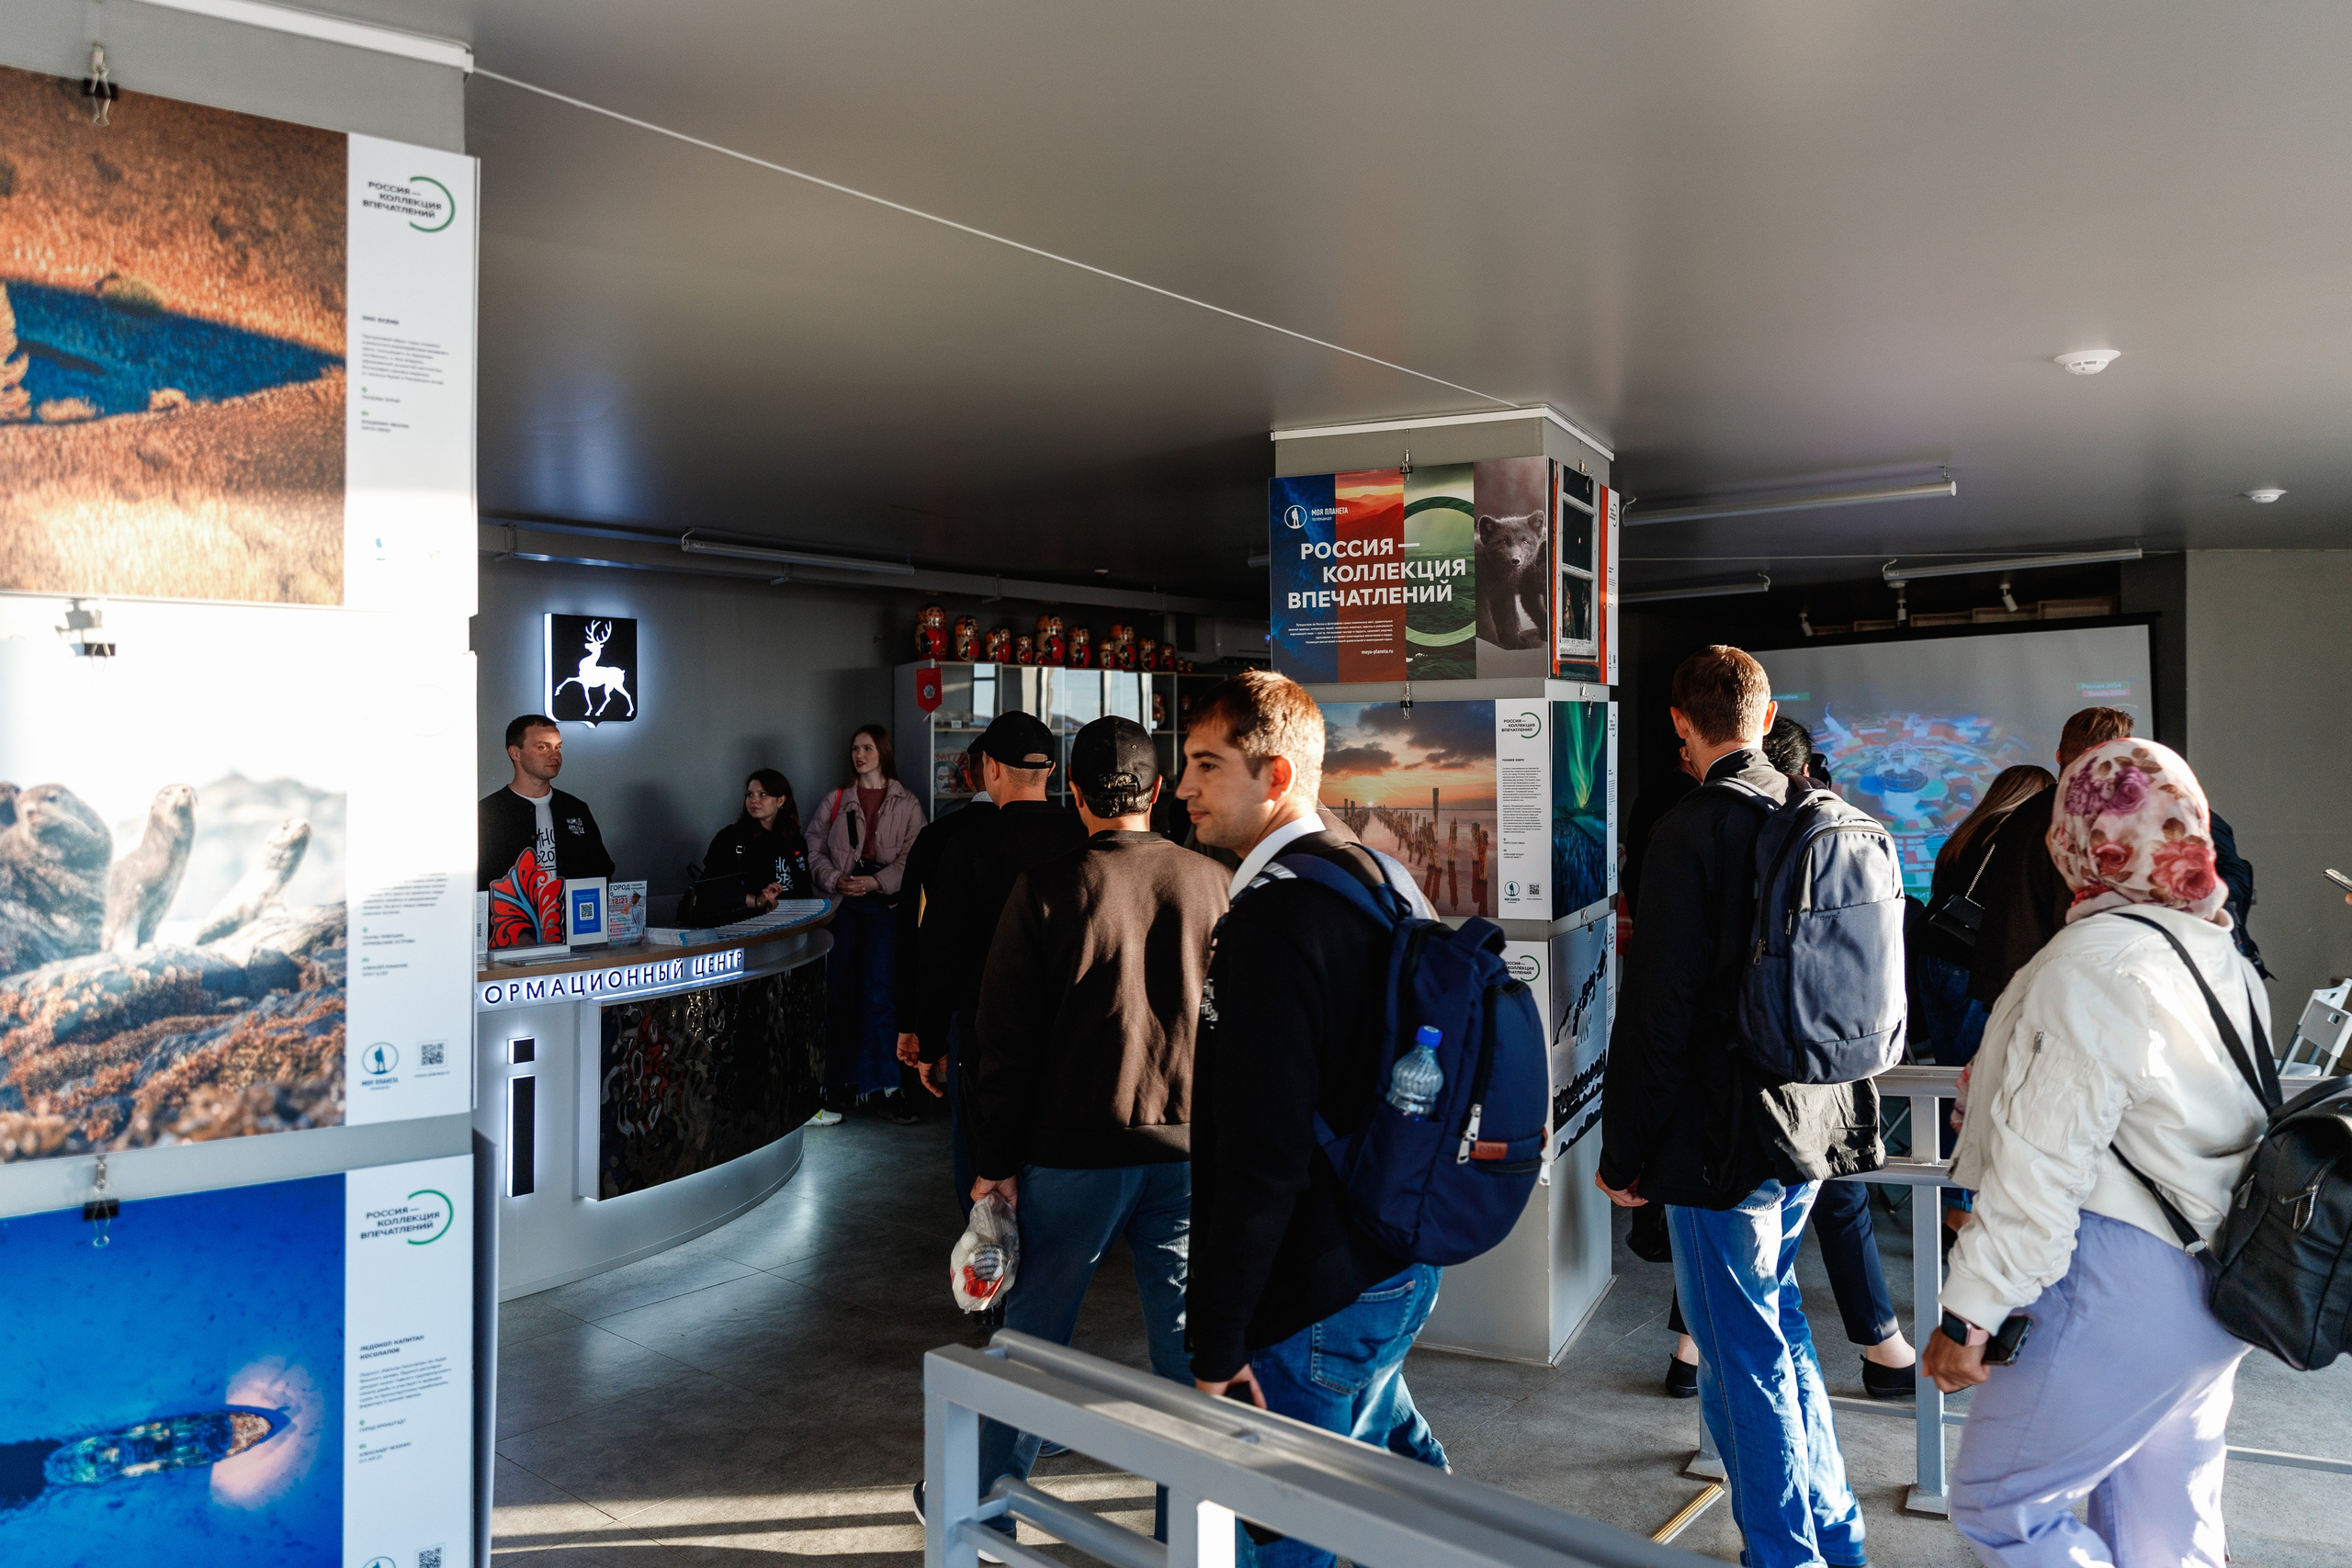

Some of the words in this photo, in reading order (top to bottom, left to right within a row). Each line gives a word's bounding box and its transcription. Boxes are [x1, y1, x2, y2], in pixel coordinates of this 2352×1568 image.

[368, 181, 411, 196] РОССИЯ
[362, 199, 435, 219] ВПЕЧАТЛЕНИЙ
[379, 193, 442, 210] КОЛЛЕКЦИЯ
[1311, 508, 1324, 516] МОЯ
[1325, 506, 1349, 515] ПЛАНЕТА
[1301, 537, 1394, 559] РОССИЯ
[1322, 558, 1466, 583] КОЛЛЕКЦИЯ
[1287, 579, 1453, 609] ВПЕЧАТЛЕНИЙ
[610, 884, 631, 892] ГОРОД
[476, 957, 684, 1005] ОРМАЦИОННЫЙ
[695, 950, 744, 977] ЦЕНТР
[367, 1207, 409, 1220] РОССИЯ
[378, 1212, 441, 1227] КОЛЛЕКЦИЯ
[360, 1221, 434, 1240] ВПЕЧАТЛЕНИЙ
[360, 1341, 392, 1352] ЛЕДОКОЛ
[393, 1335, 424, 1346] КАПИТАН
[360, 1348, 401, 1359] КОСОЛАПОВ
